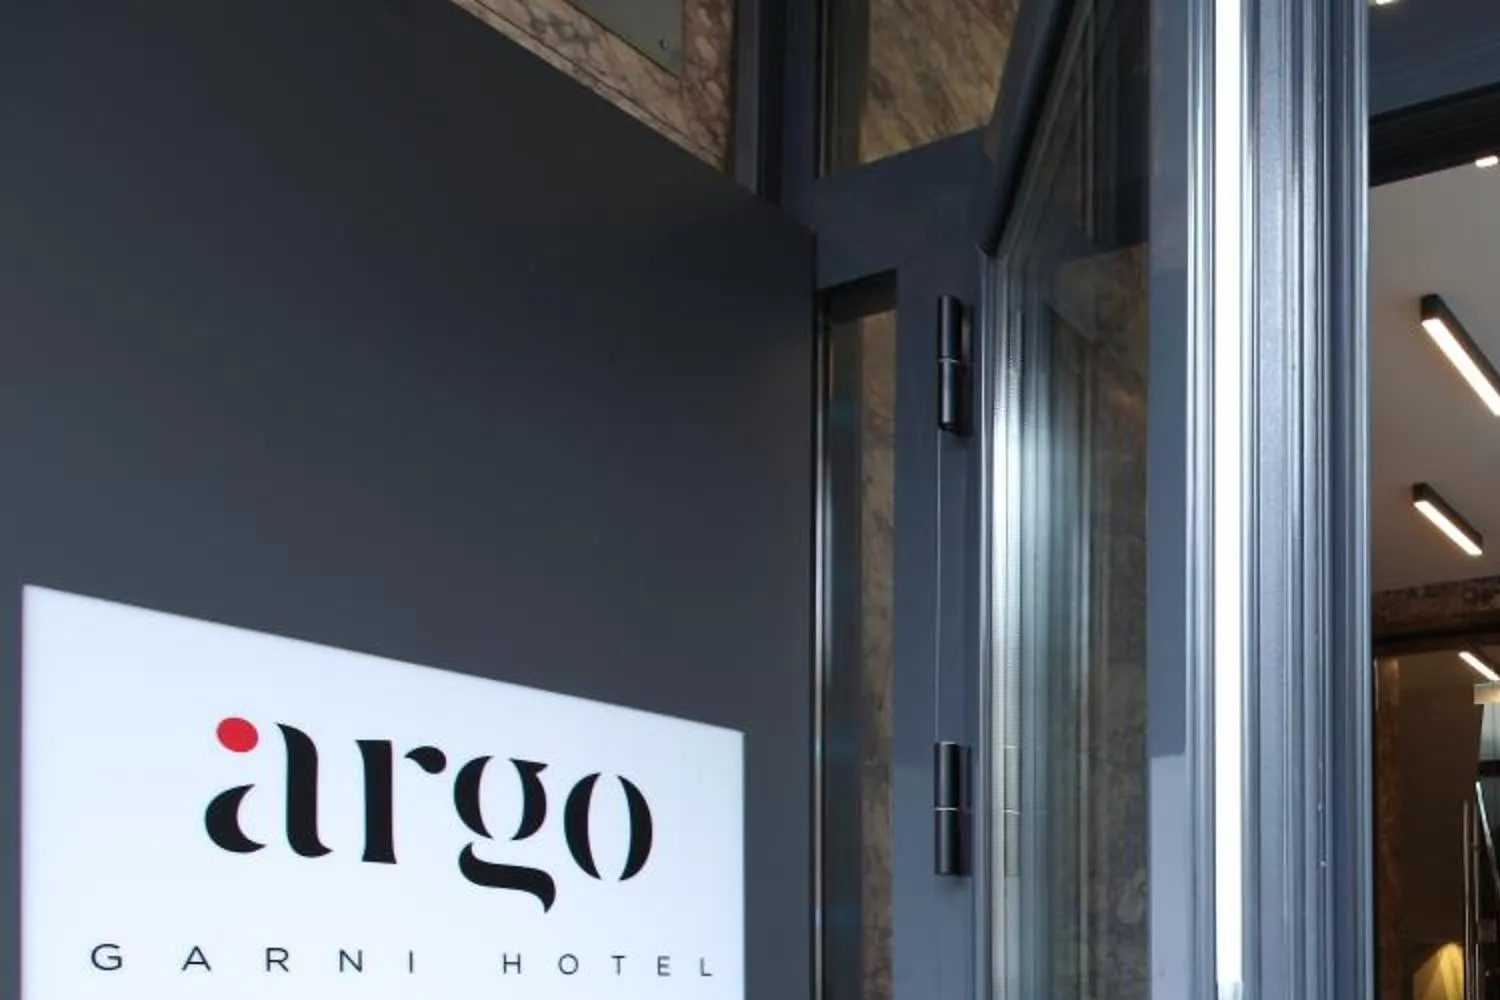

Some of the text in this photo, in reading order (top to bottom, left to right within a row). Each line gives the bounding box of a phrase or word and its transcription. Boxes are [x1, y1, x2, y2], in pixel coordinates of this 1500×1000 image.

[204, 716, 653, 914] argo
[90, 943, 714, 977] GARNI HOTEL
